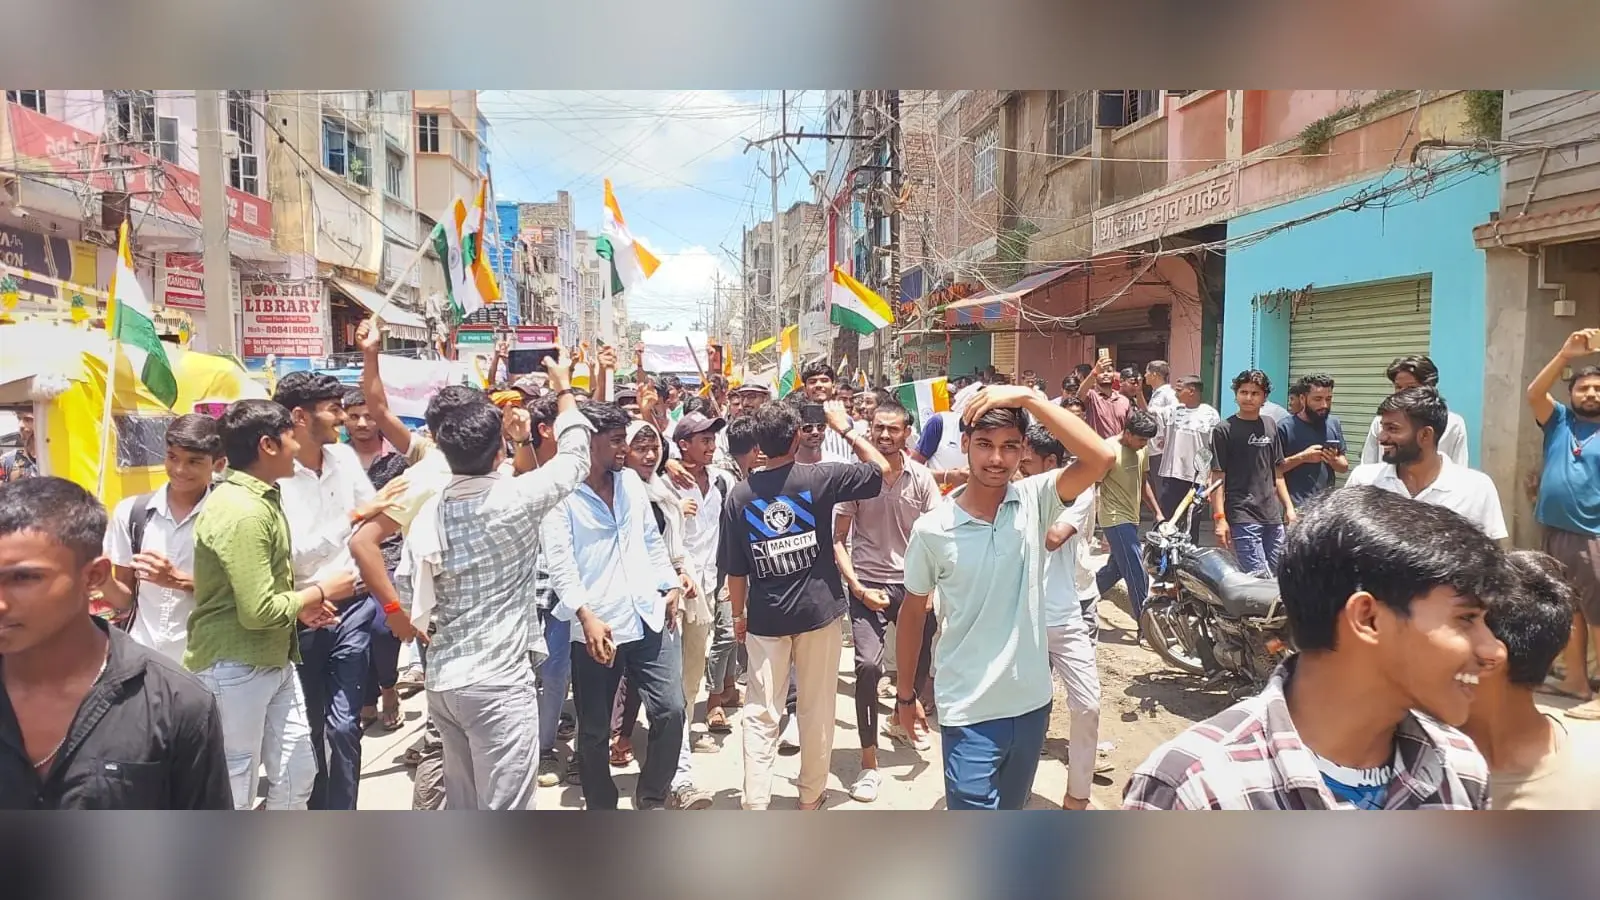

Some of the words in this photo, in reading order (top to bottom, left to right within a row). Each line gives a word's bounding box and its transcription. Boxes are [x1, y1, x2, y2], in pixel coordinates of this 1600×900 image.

[245, 299, 320, 313] LIBRARY
[266, 326, 319, 334] 8084180093
[770, 540, 791, 550] MAN
[793, 534, 812, 546] CITY
